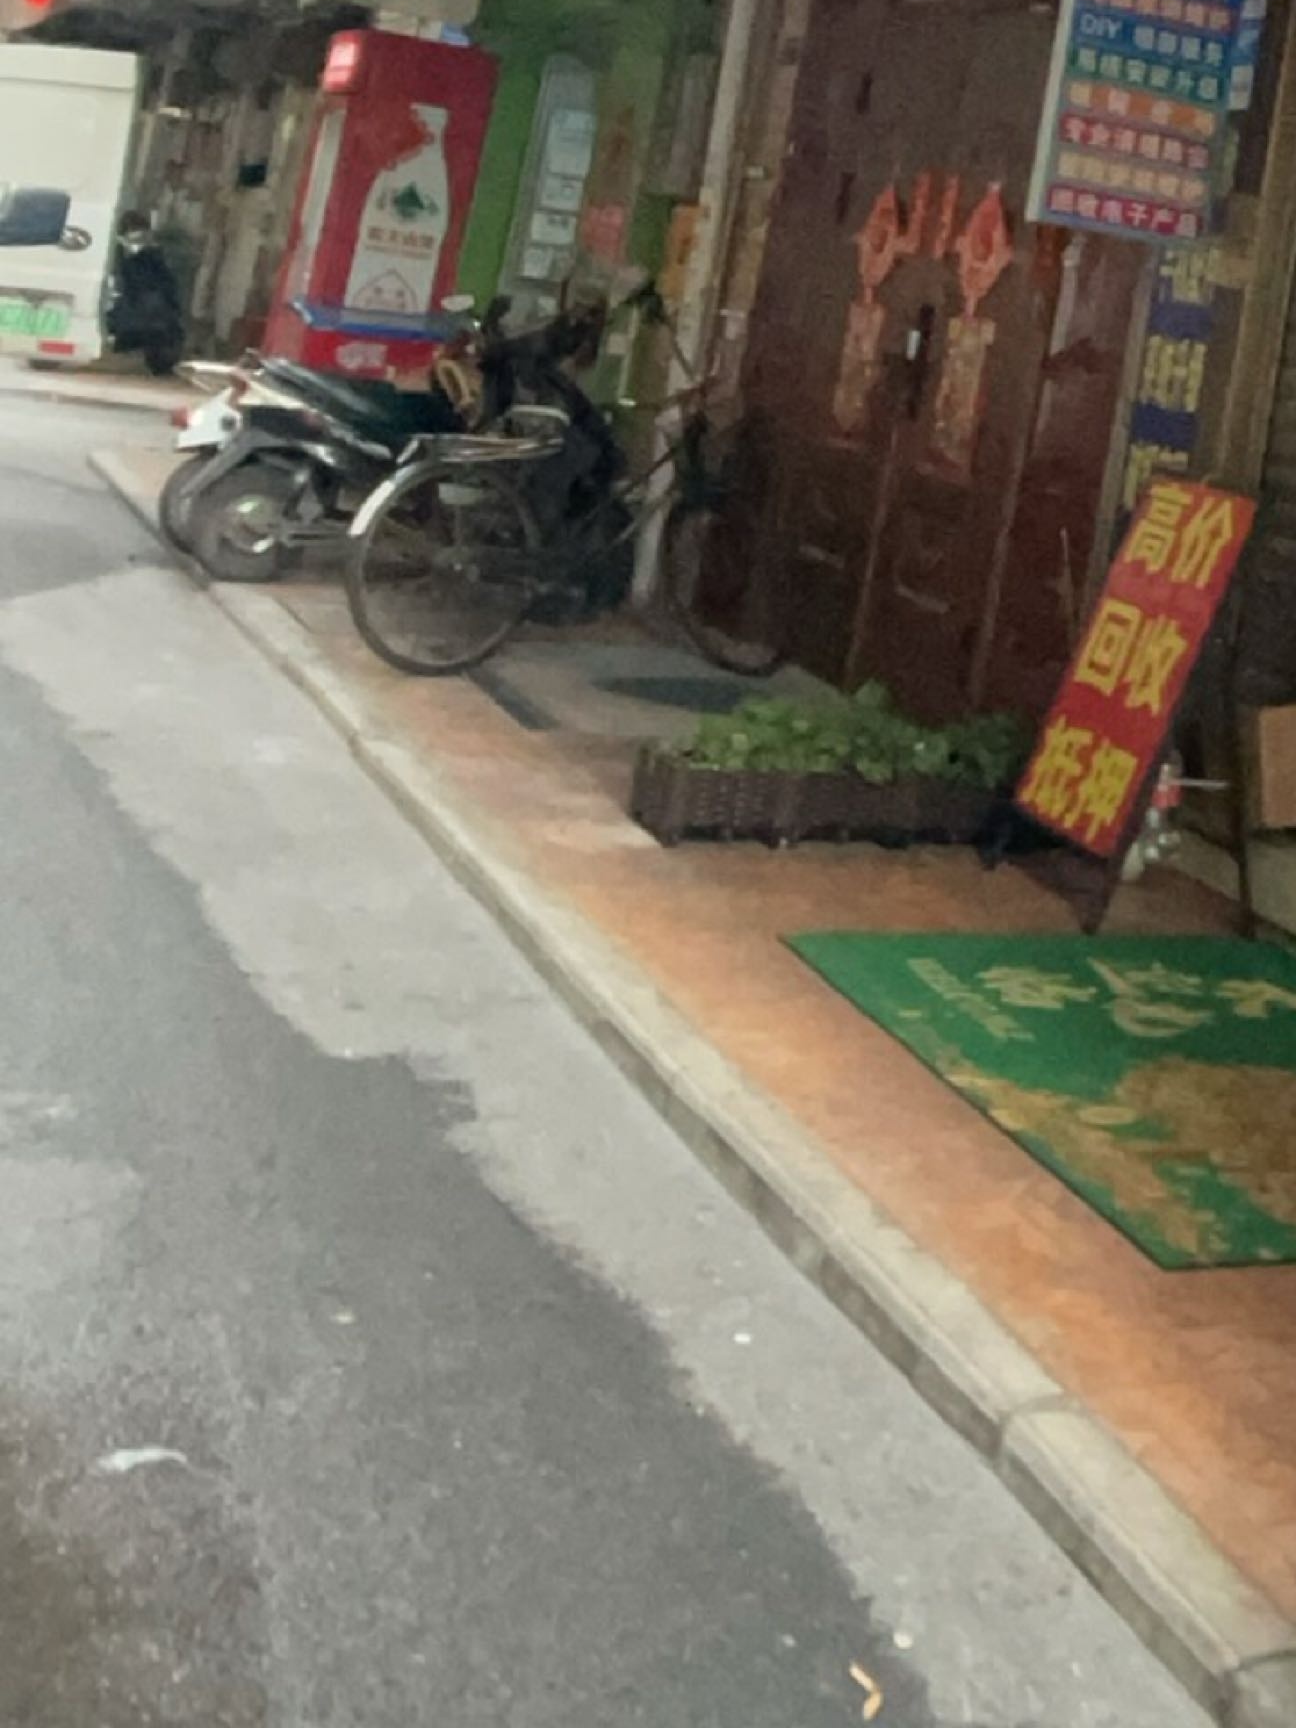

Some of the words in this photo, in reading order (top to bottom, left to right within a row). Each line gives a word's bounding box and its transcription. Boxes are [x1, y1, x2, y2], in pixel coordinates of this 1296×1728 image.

[1079, 12, 1122, 40] DIY
[1125, 480, 1234, 590] 高价
[1073, 597, 1188, 716] 回收
